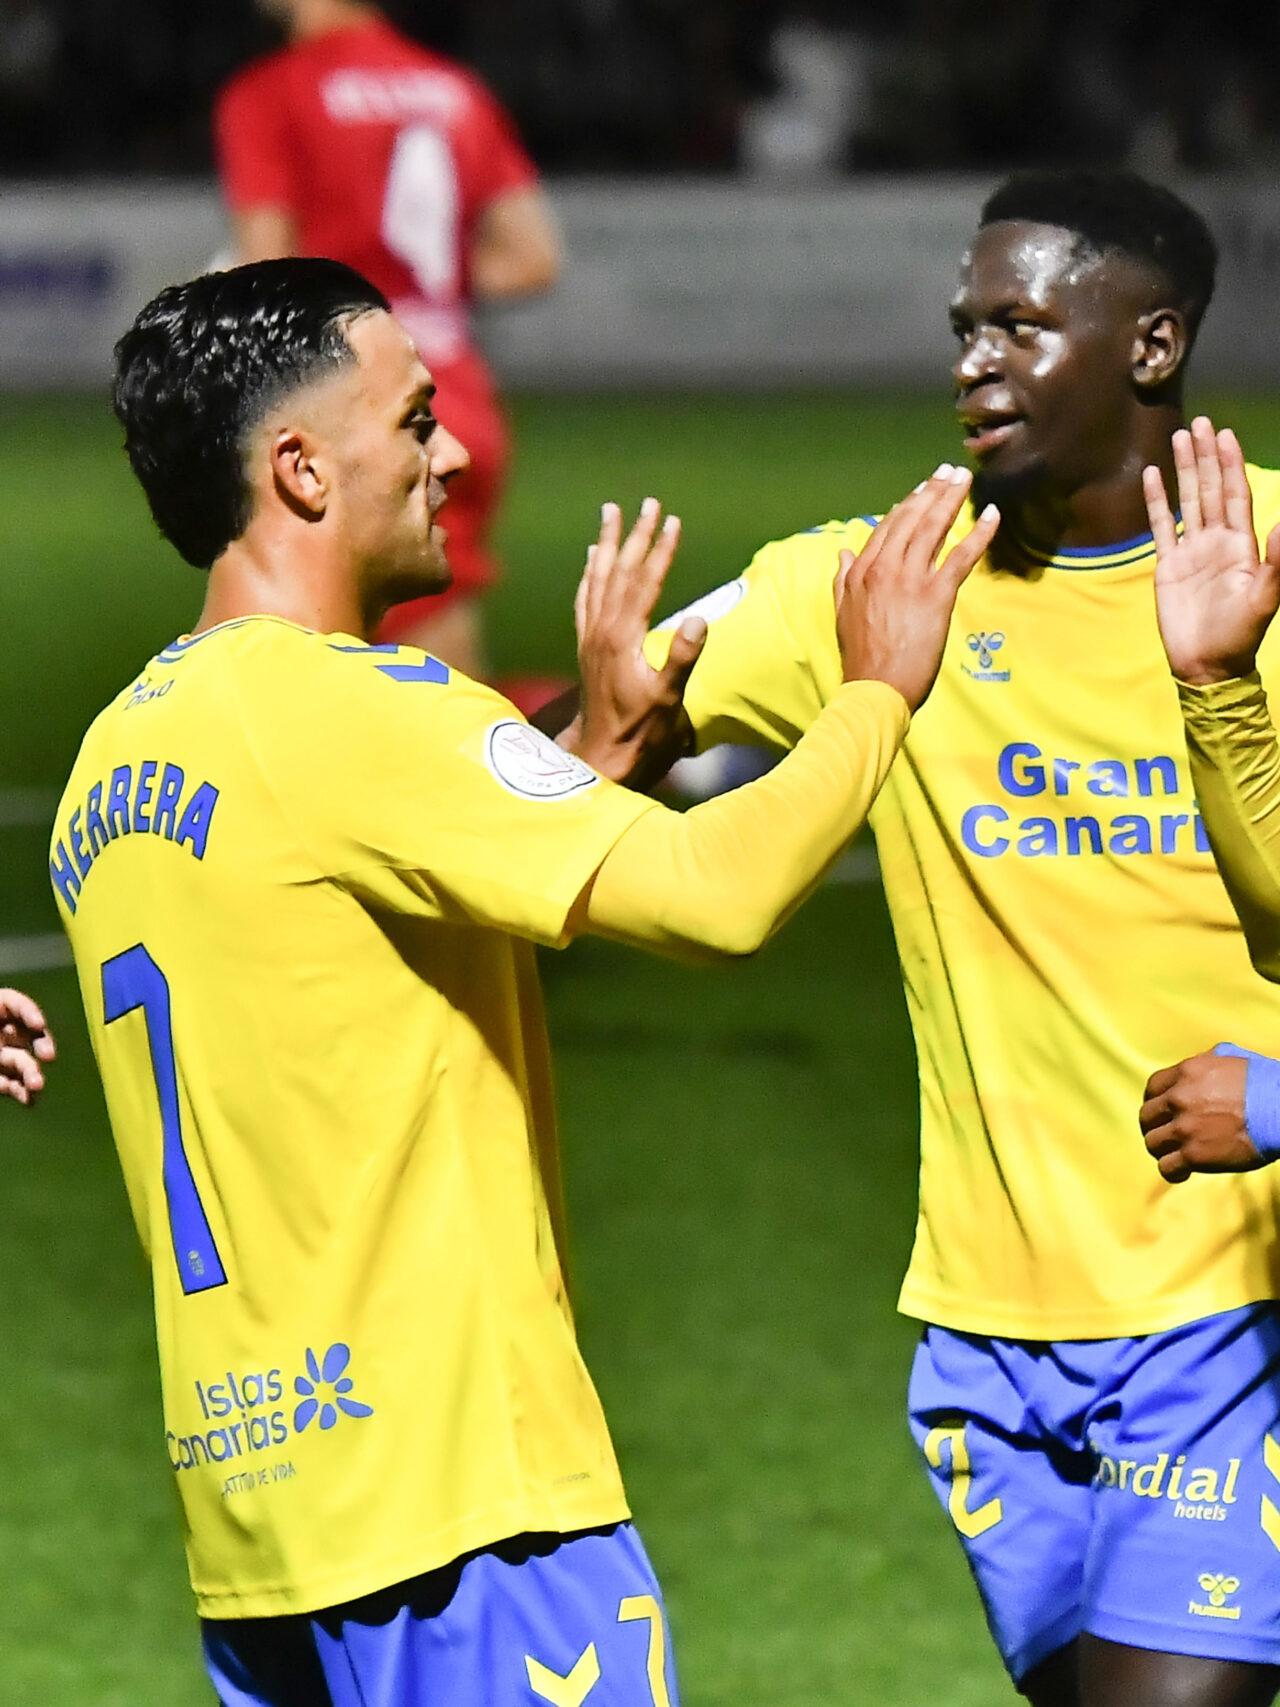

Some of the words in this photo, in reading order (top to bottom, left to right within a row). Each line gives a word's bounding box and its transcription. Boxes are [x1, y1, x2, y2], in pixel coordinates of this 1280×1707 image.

[998, 741, 1178, 798] Gran
[51, 760, 220, 917] HERRERA
[961, 800, 1213, 858] Canari
[101, 942, 229, 1297] 7
[195, 1368, 283, 1421] Islas
[166, 1411, 288, 1472] Canarias
[924, 1421, 1003, 1539] 2
[1096, 1453, 1242, 1505] ordial
[1173, 1501, 1228, 1522] hotels
[617, 1594, 672, 1707] 7
